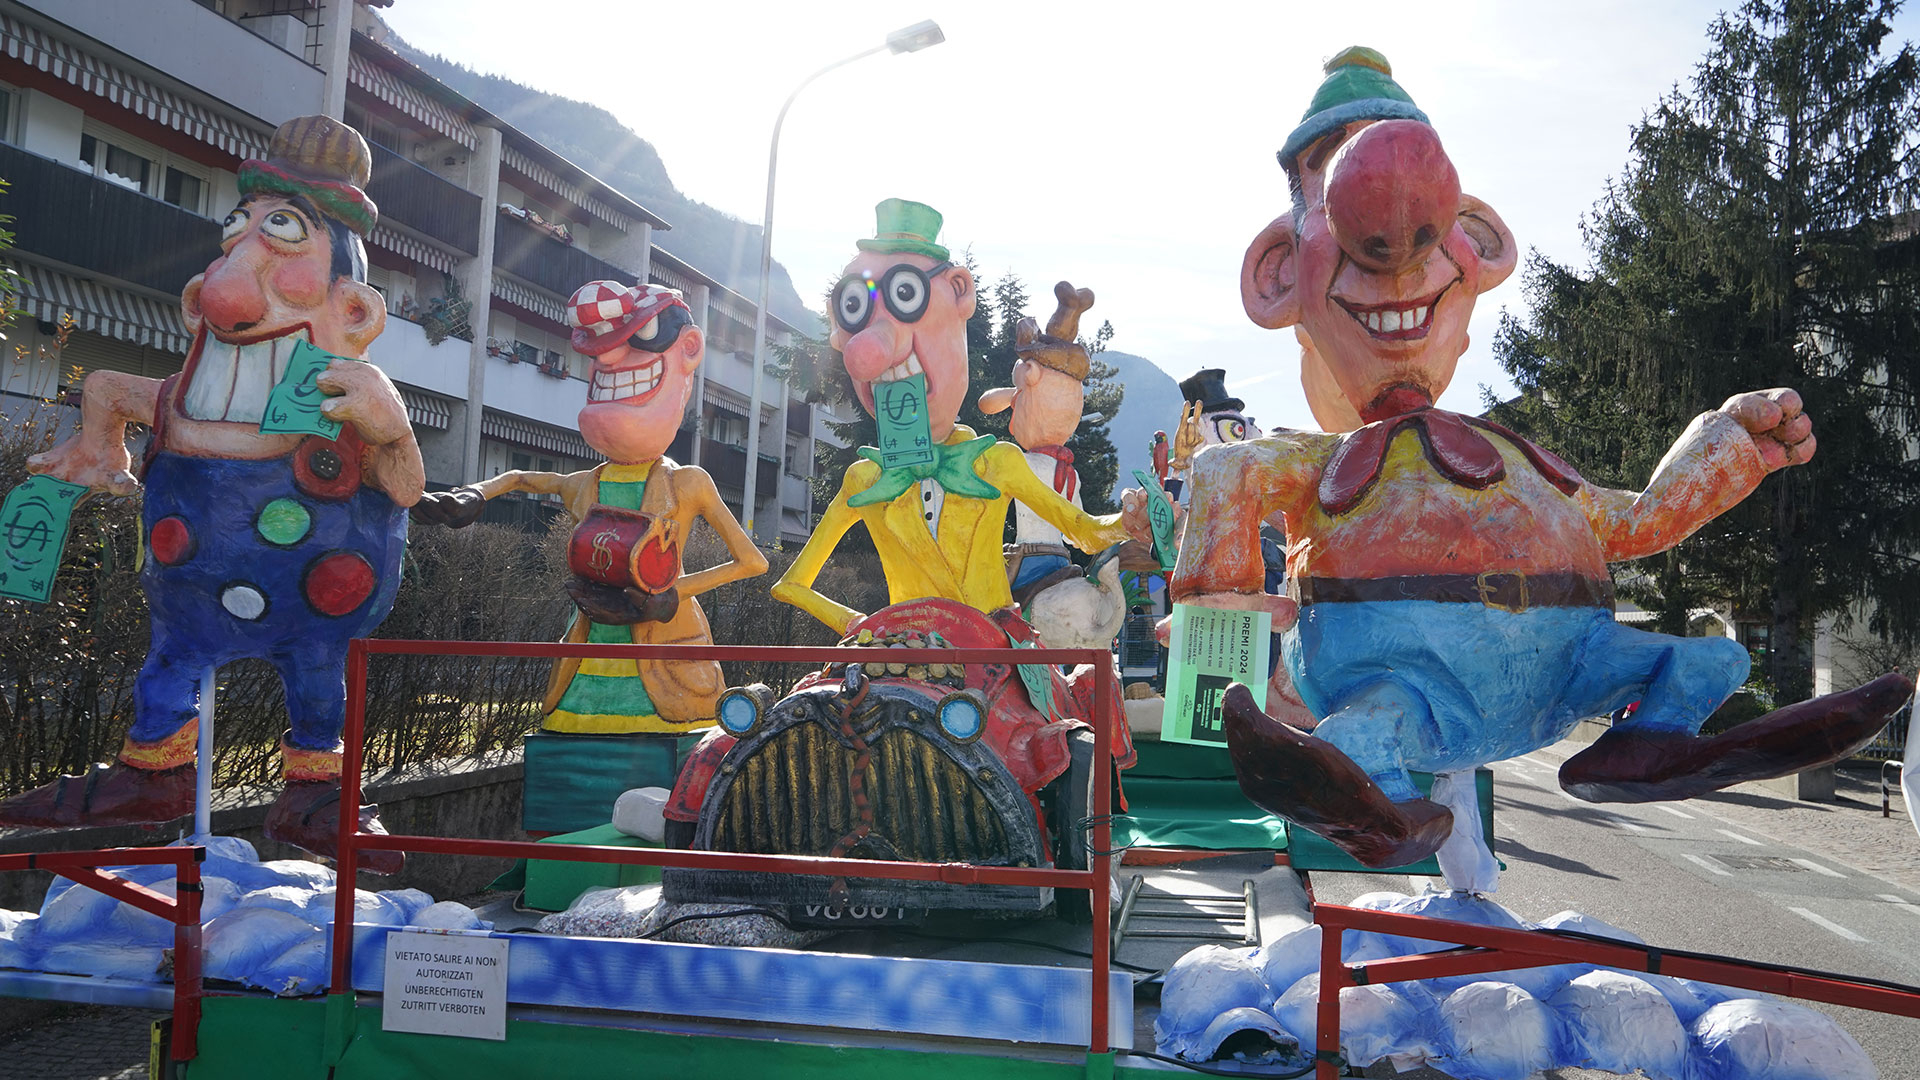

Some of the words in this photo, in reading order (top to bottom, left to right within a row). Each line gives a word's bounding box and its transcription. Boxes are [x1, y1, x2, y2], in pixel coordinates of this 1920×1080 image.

[1241, 616, 1250, 646] PREMI
[1239, 649, 1248, 674] 2024
[395, 951, 431, 962] VIETATO
[434, 954, 462, 964] SALIRE
[464, 956, 473, 964] AI
[476, 957, 496, 966] NON
[416, 969, 473, 980] AUTORIZZATI
[405, 985, 483, 999] UNBERECHTIGTEN
[401, 1000, 437, 1011] ZUTRITT
[439, 1003, 485, 1015] VERBOTEN
